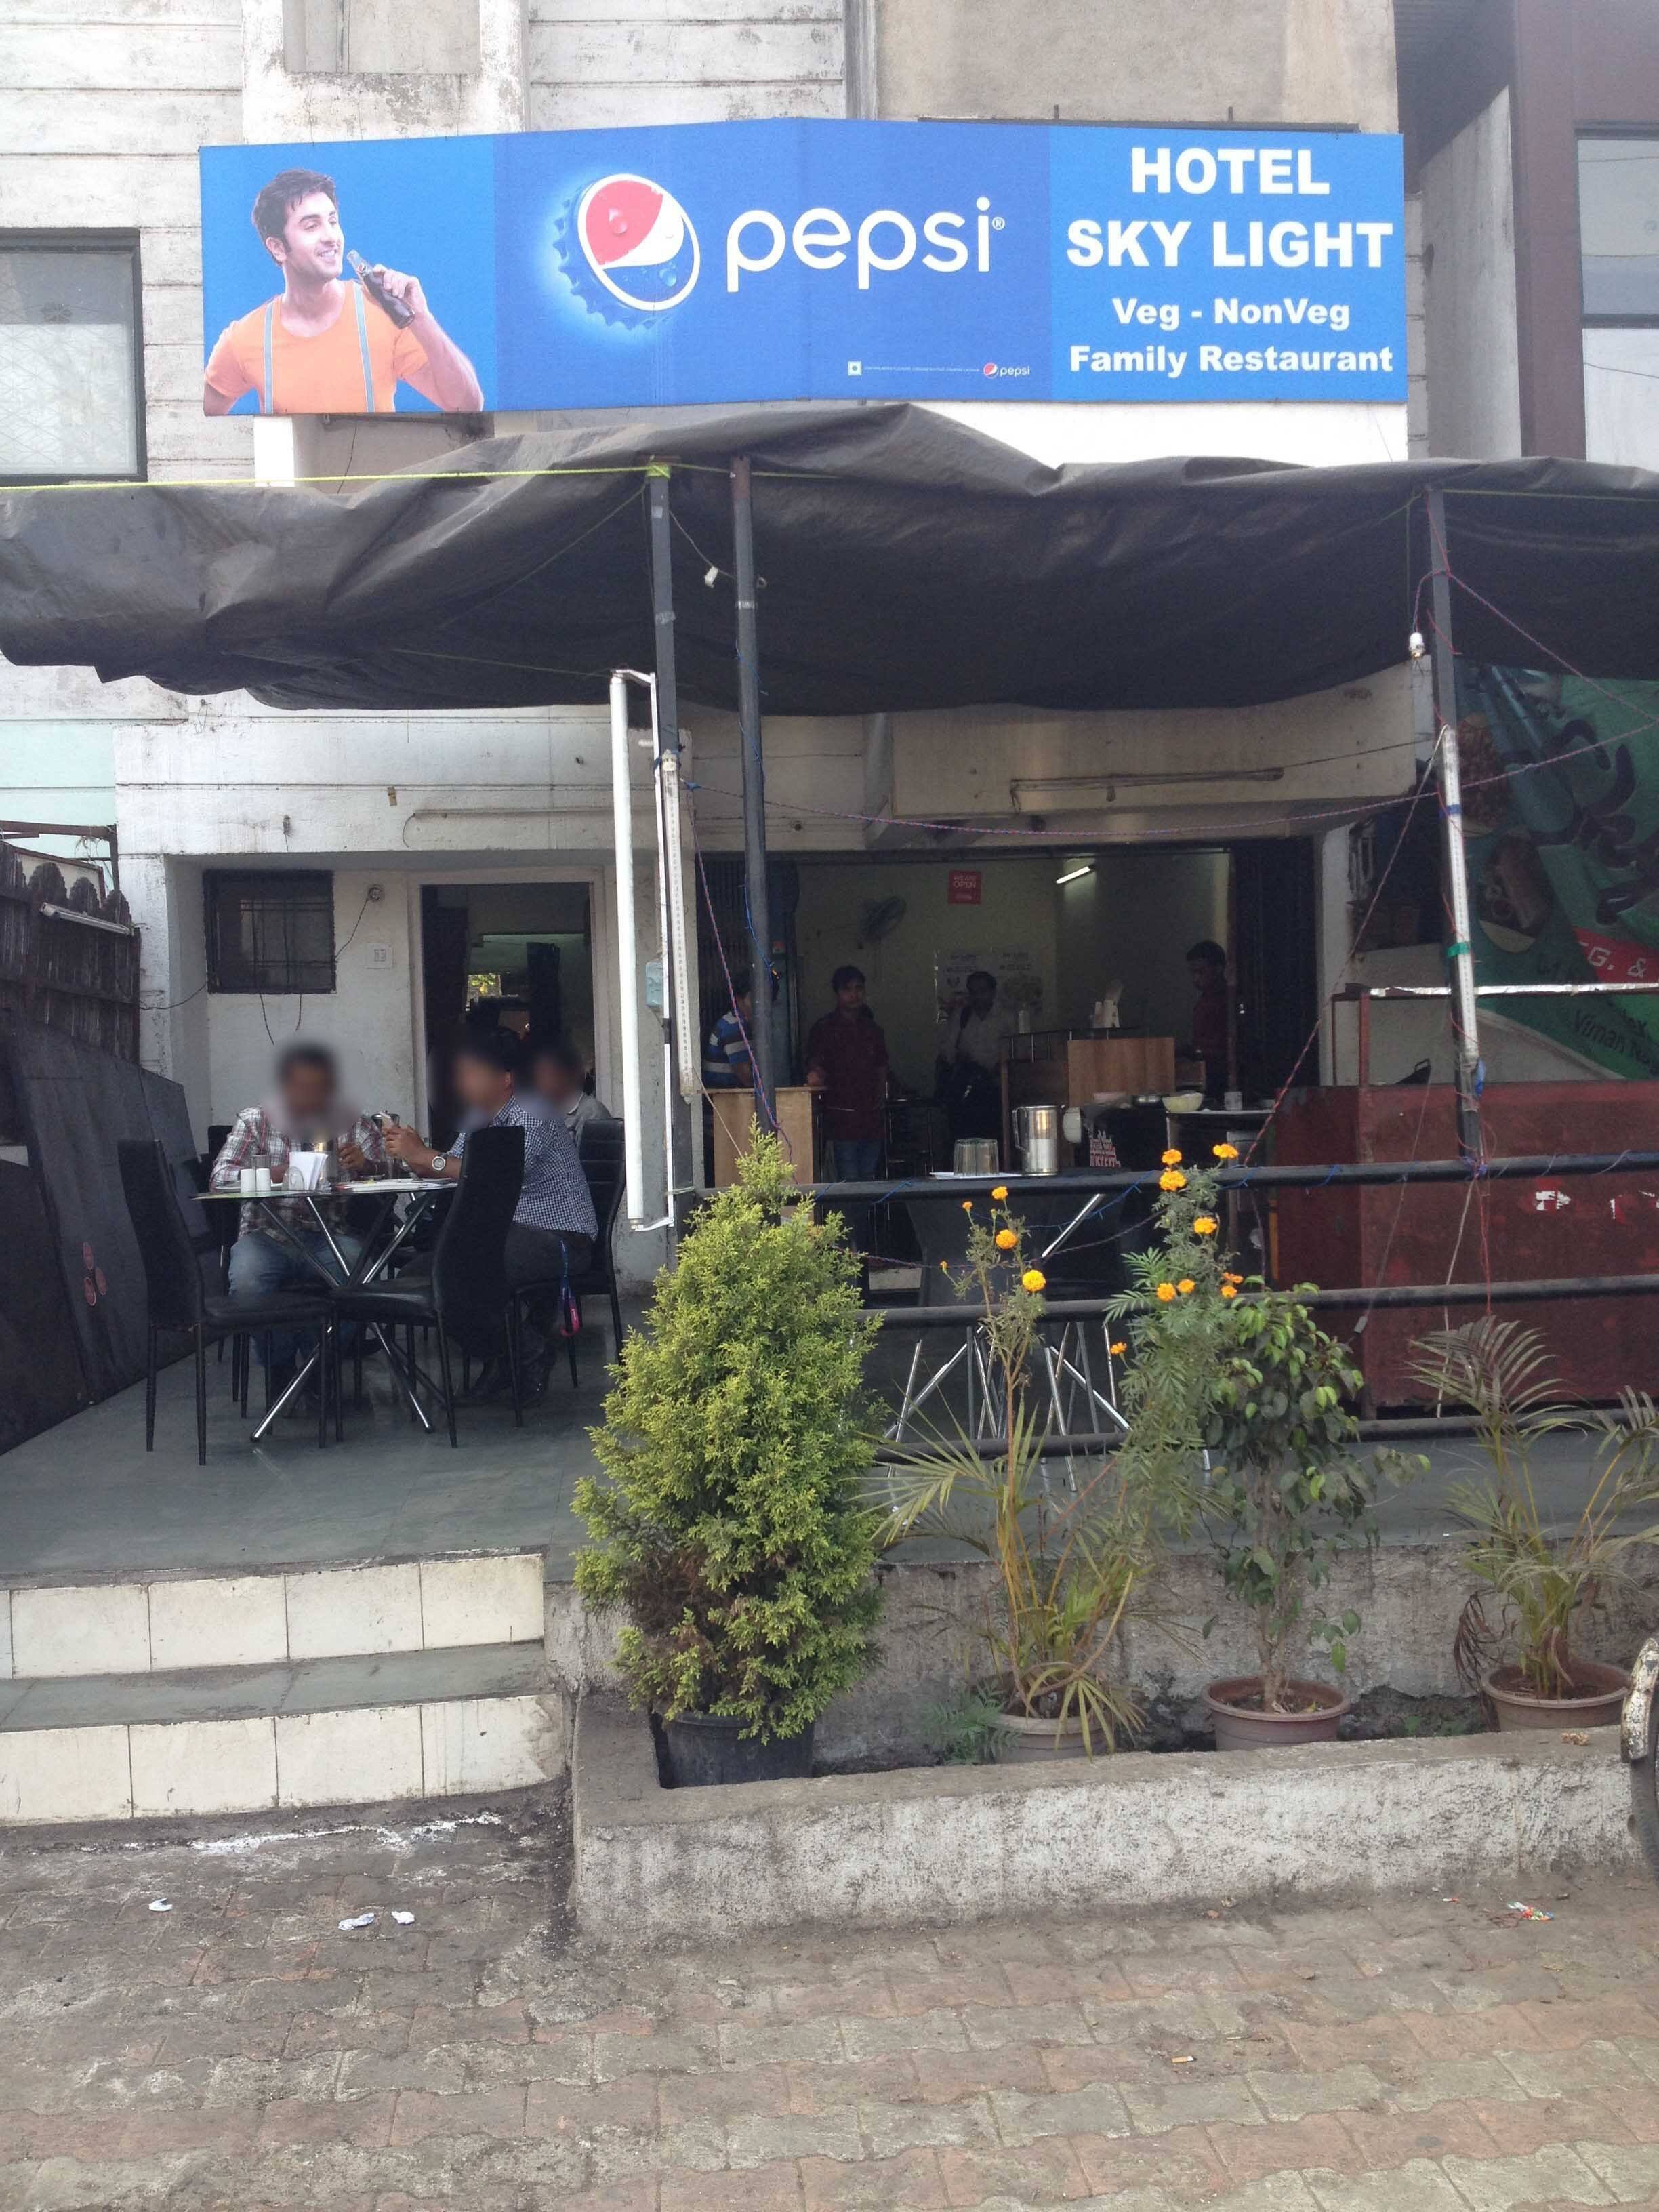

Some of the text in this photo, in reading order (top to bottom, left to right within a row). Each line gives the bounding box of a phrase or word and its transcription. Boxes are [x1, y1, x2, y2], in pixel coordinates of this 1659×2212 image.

[1131, 147, 1330, 195] HOTEL
[1066, 219, 1394, 268] SKY LIGHT
[1111, 297, 1350, 331] Veg - NonVeg
[1000, 365, 1030, 377] pepsi
[1070, 346, 1393, 378] Family Restaurant
